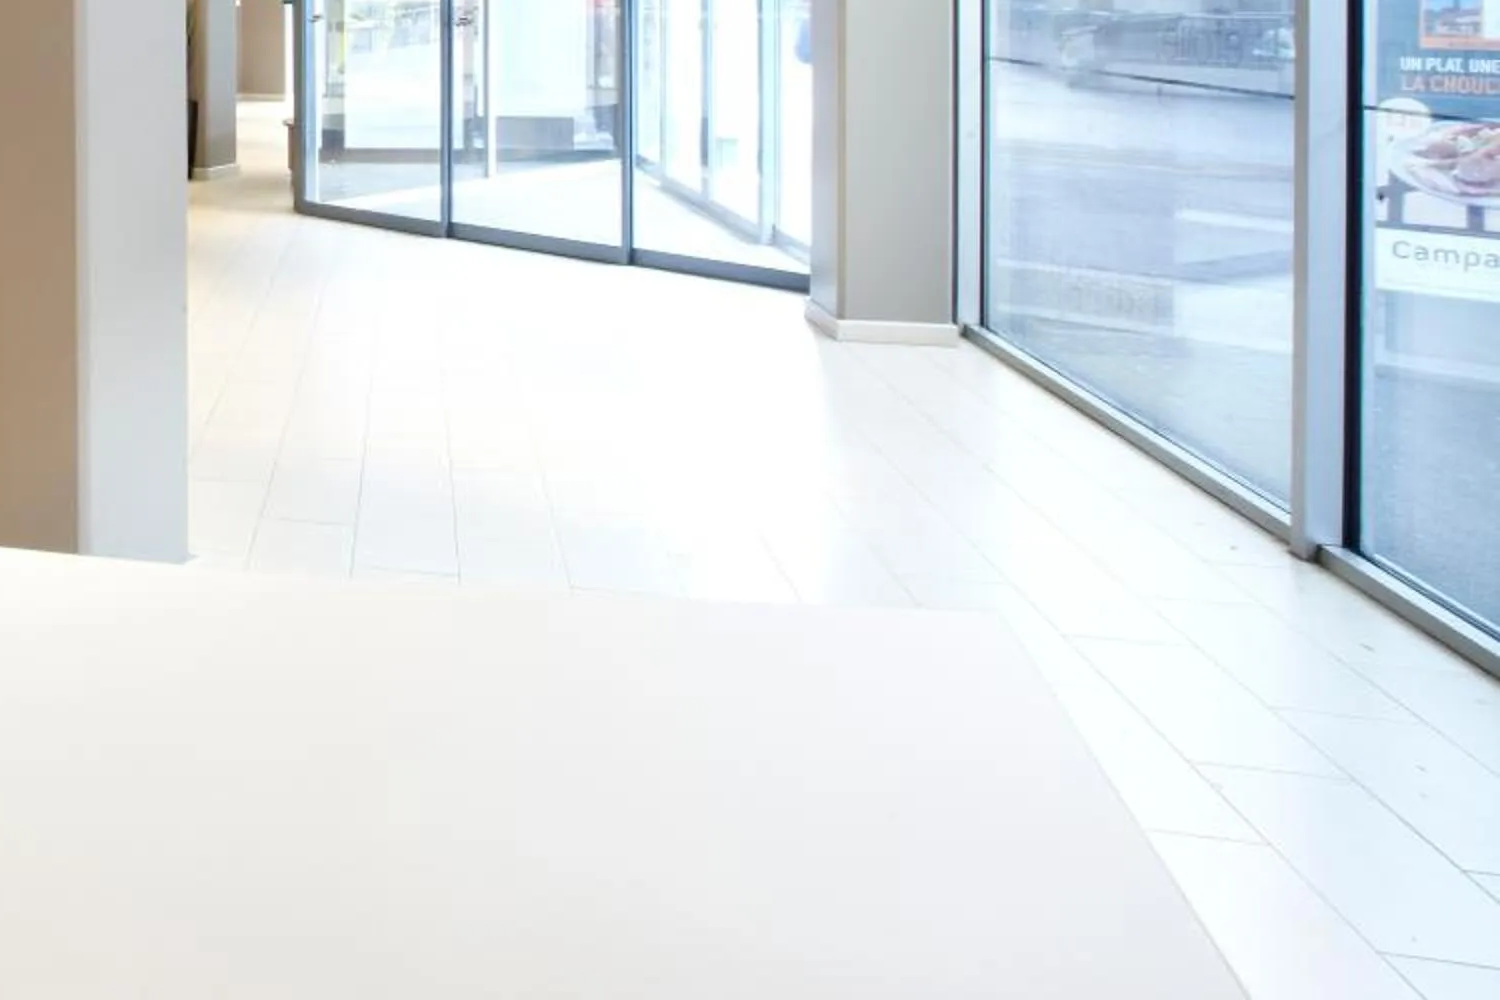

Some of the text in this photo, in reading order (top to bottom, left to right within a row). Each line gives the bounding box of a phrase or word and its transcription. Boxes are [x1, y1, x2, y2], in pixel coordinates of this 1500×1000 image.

[1399, 55, 1422, 72] UN
[1400, 73, 1426, 92] LA
[1391, 239, 1500, 273] Campa
